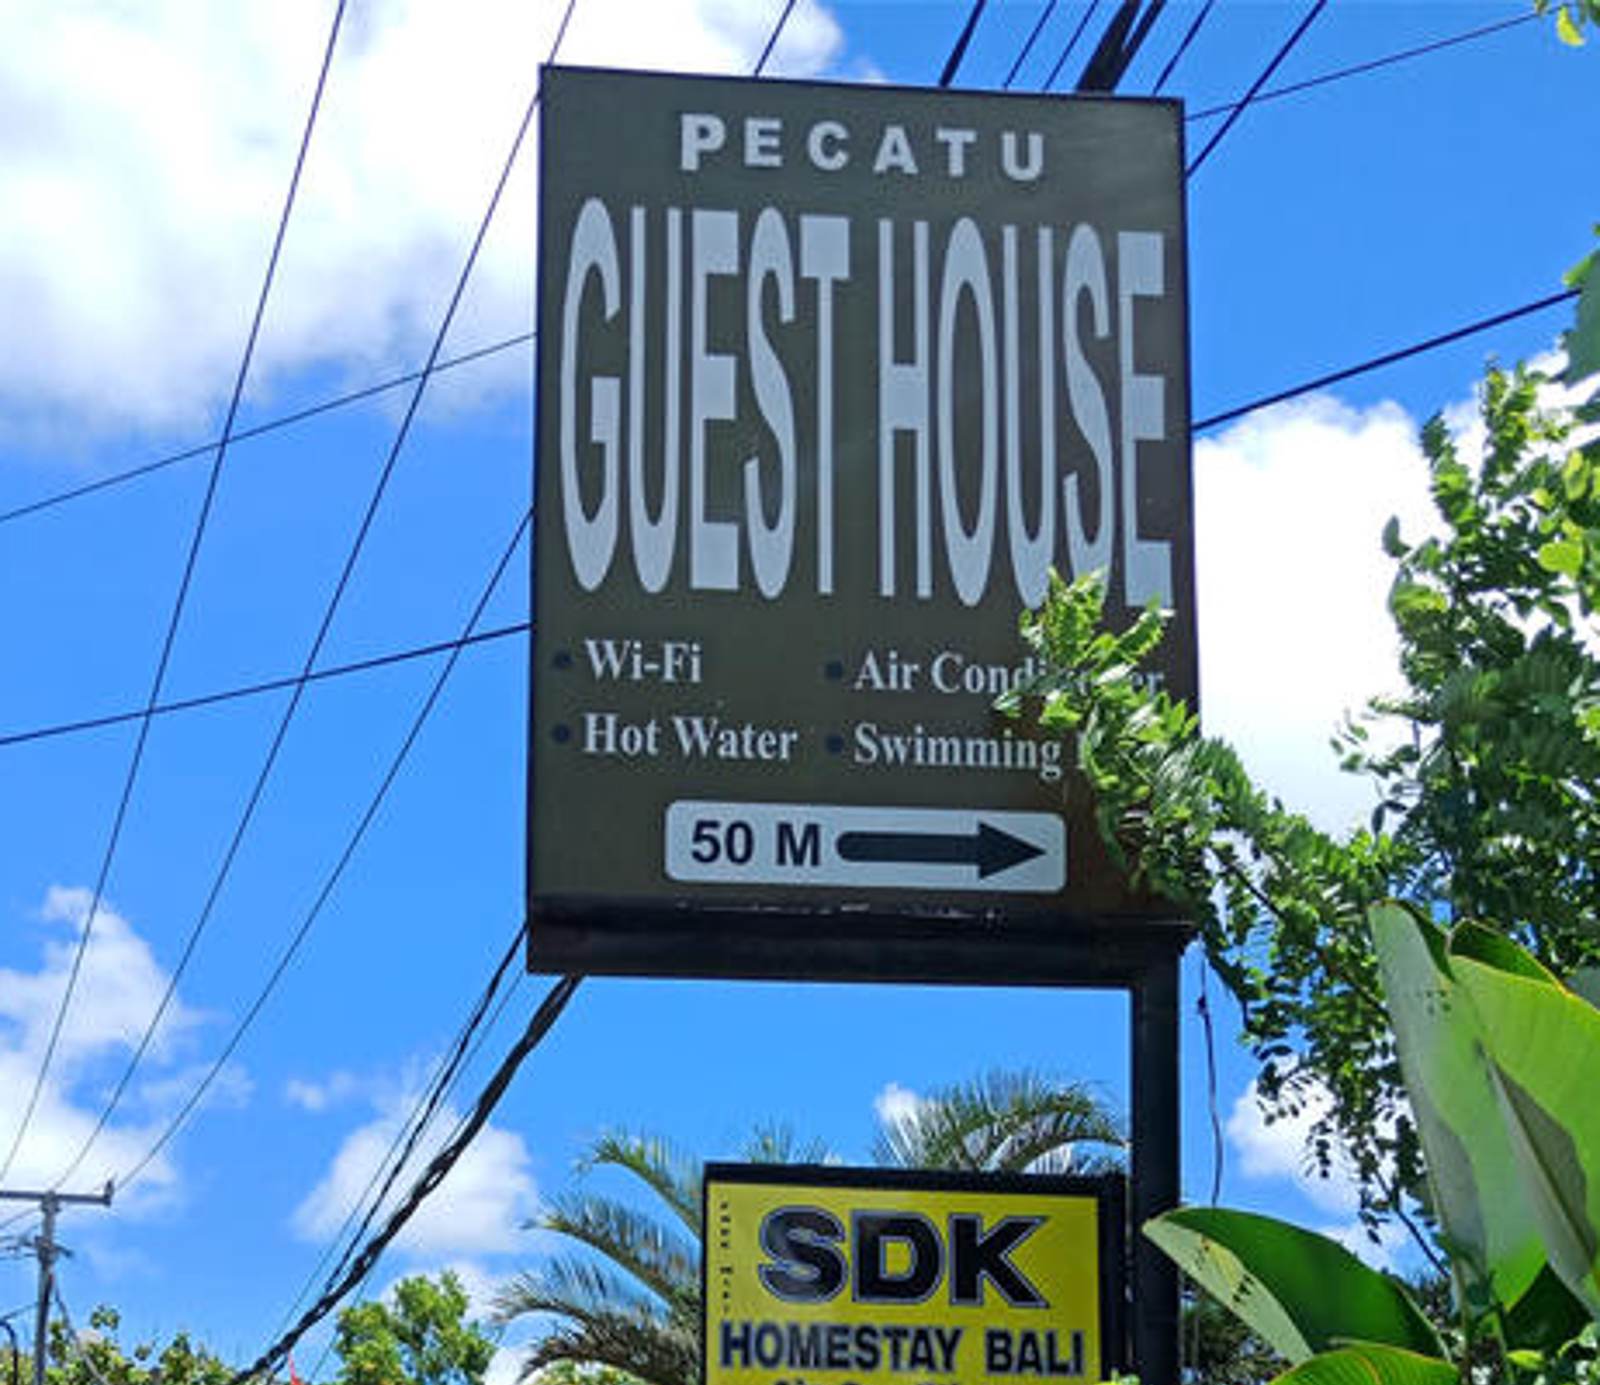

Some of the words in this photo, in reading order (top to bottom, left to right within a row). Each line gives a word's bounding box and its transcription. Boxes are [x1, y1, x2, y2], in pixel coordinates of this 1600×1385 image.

[680, 113, 1045, 181] PECATU
[560, 198, 851, 600] GUEST
[878, 215, 1173, 607] HOUSE
[584, 638, 702, 683] Wi-Fi
[854, 650, 920, 691] Air
[583, 712, 661, 755] Hot
[672, 715, 798, 760] Water
[854, 721, 1062, 781] Swimming
[690, 819, 754, 864] 50
[775, 822, 821, 867] M
[757, 1204, 1051, 1308] SDK
[719, 1320, 963, 1372] HOMESTAY
[985, 1330, 1085, 1377] BALI
